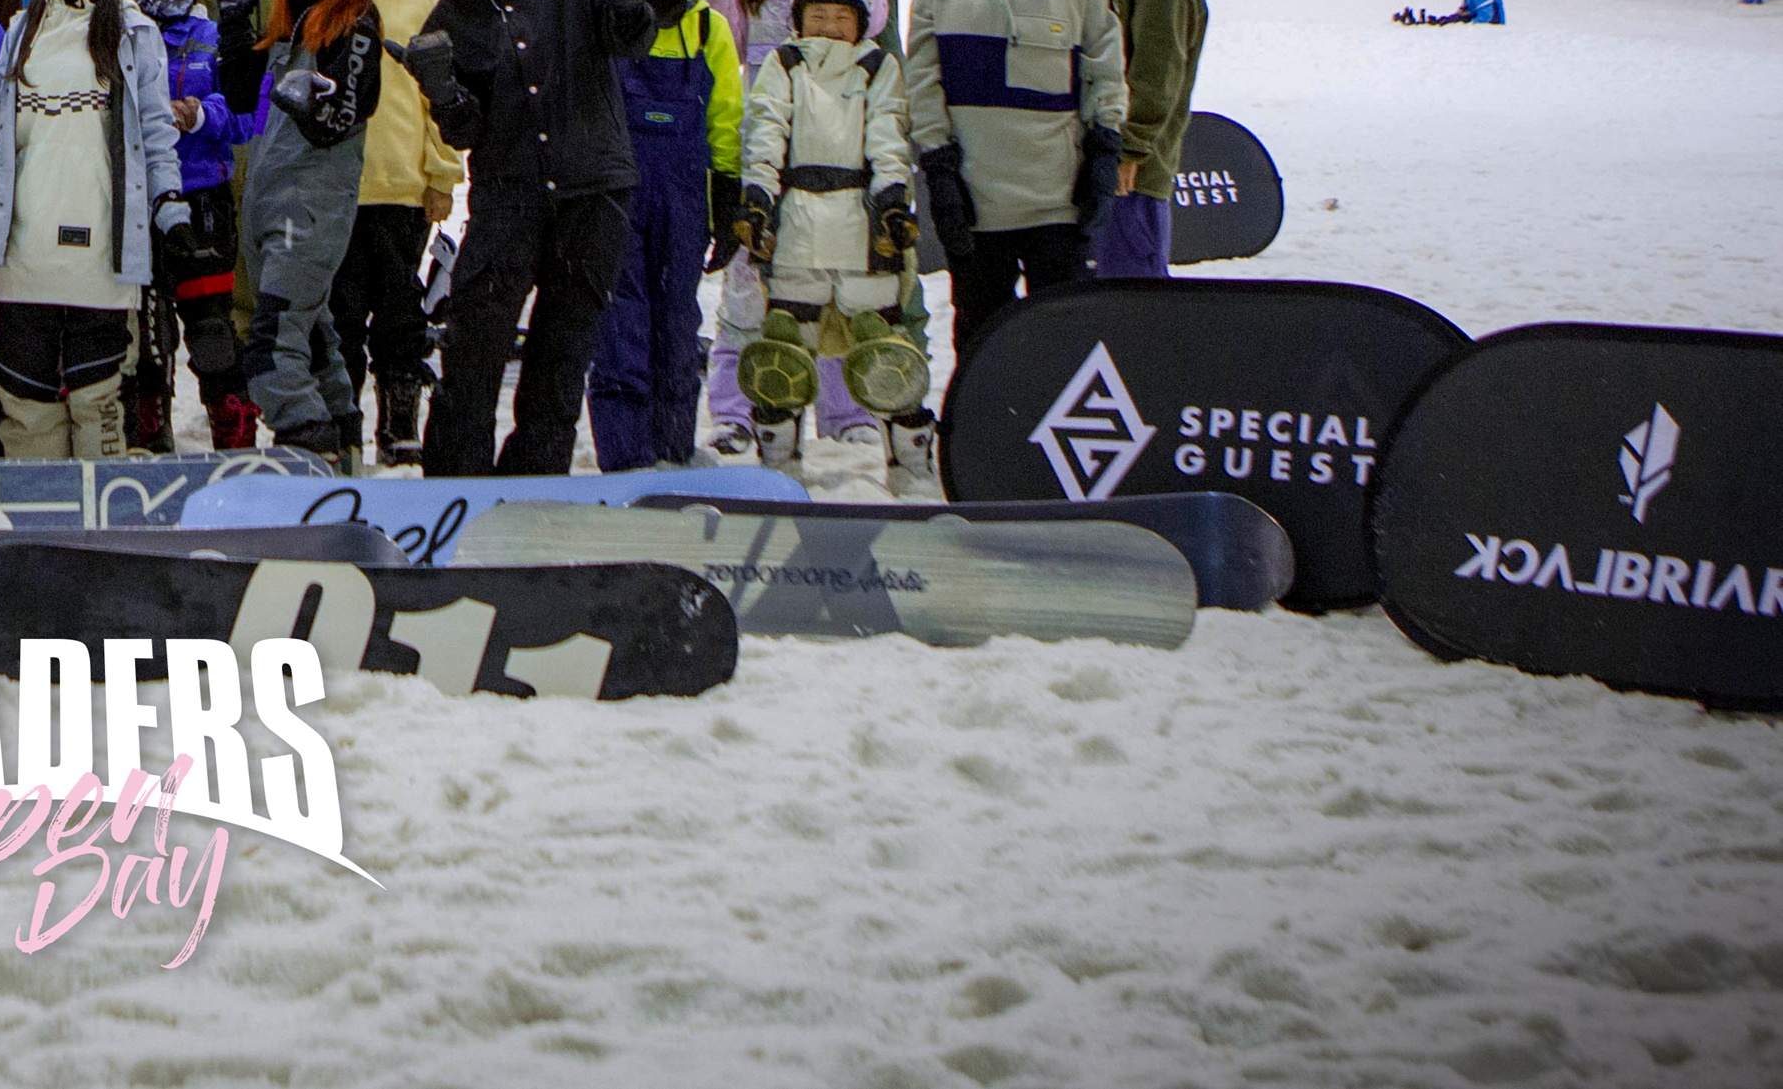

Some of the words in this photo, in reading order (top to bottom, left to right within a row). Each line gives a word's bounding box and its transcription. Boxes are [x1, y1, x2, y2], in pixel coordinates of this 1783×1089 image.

[1171, 170, 1236, 189] ECIAL
[1175, 187, 1238, 207] UEST
[1179, 406, 1377, 450] SPECIAL
[1174, 444, 1377, 488] GUEST
